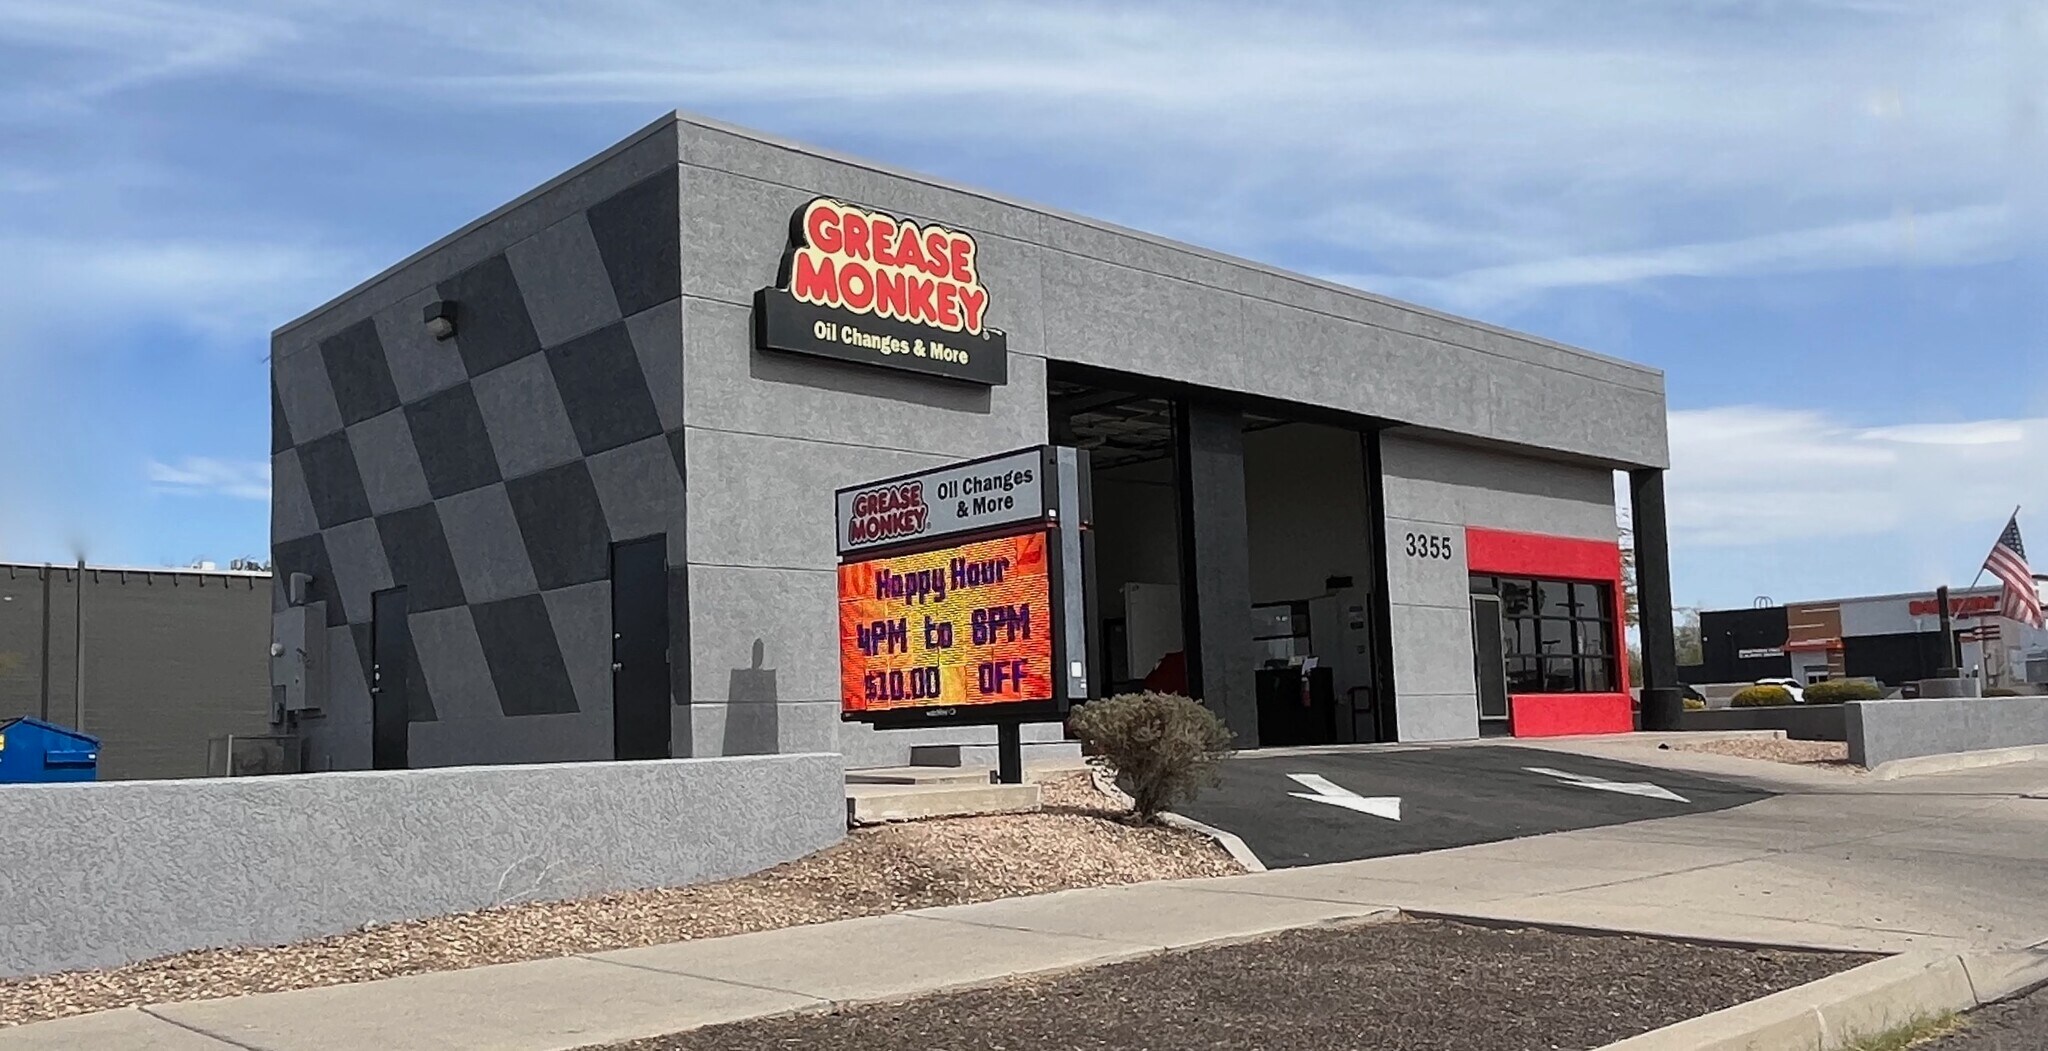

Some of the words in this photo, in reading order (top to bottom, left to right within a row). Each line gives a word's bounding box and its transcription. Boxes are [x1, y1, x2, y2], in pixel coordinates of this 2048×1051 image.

[807, 206, 972, 283] GREASE
[795, 252, 985, 331] MONKEY
[813, 321, 837, 341] Oil
[841, 326, 910, 355] Changes
[912, 339, 928, 358] &
[930, 344, 969, 365] More
[855, 485, 921, 518] GREASE
[937, 480, 958, 500] Oil
[962, 469, 1033, 495] Changes
[851, 507, 926, 542] MONKEY
[956, 500, 969, 518] &
[972, 496, 1014, 516] More
[1405, 533, 1452, 560] 3355
[875, 568, 946, 605] Happy
[949, 556, 1010, 591] Hour
[856, 617, 908, 656] 4PM
[924, 615, 953, 650] to
[864, 665, 941, 702] $10.00
[978, 658, 1029, 694] OFF
